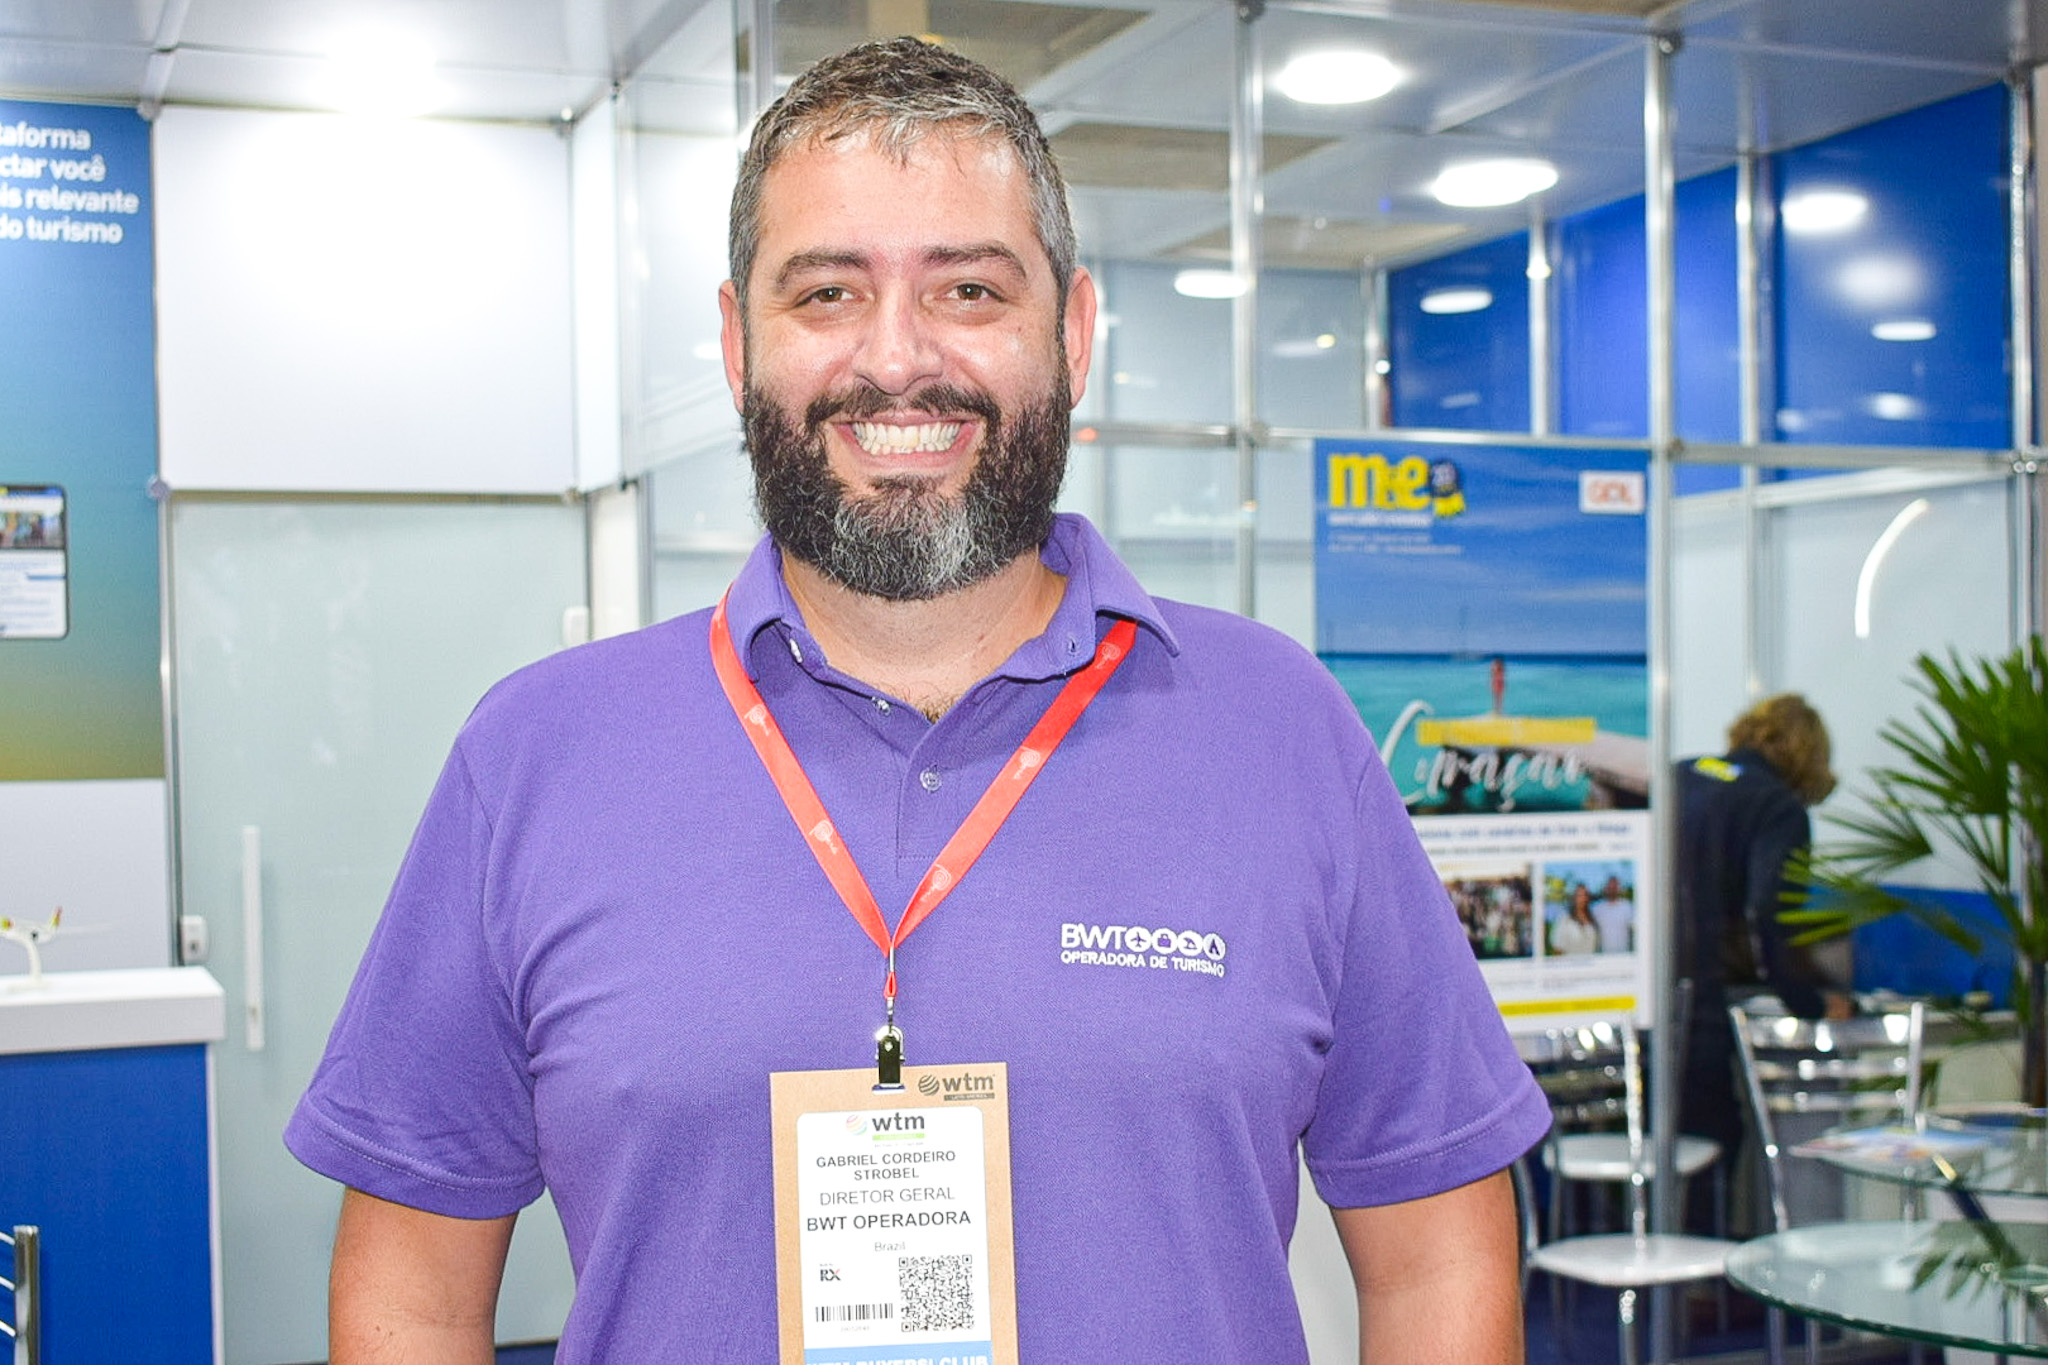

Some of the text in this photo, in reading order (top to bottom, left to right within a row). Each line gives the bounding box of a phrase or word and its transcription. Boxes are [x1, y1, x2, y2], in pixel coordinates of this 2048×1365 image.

[49, 153, 107, 183] você
[24, 184, 140, 215] relevante
[25, 214, 124, 245] turismo
[1061, 922, 1128, 950] BWT
[1060, 950, 1225, 978] OPERADORA DE TURISMO
[942, 1072, 994, 1092] wtm
[871, 1112, 925, 1131] wtm
[816, 1150, 956, 1168] GABRIEL CORDEIRO
[854, 1167, 919, 1181] STROBEL
[819, 1187, 955, 1206] DIRETOR GERAL
[807, 1210, 971, 1232] BWT OPERADORA
